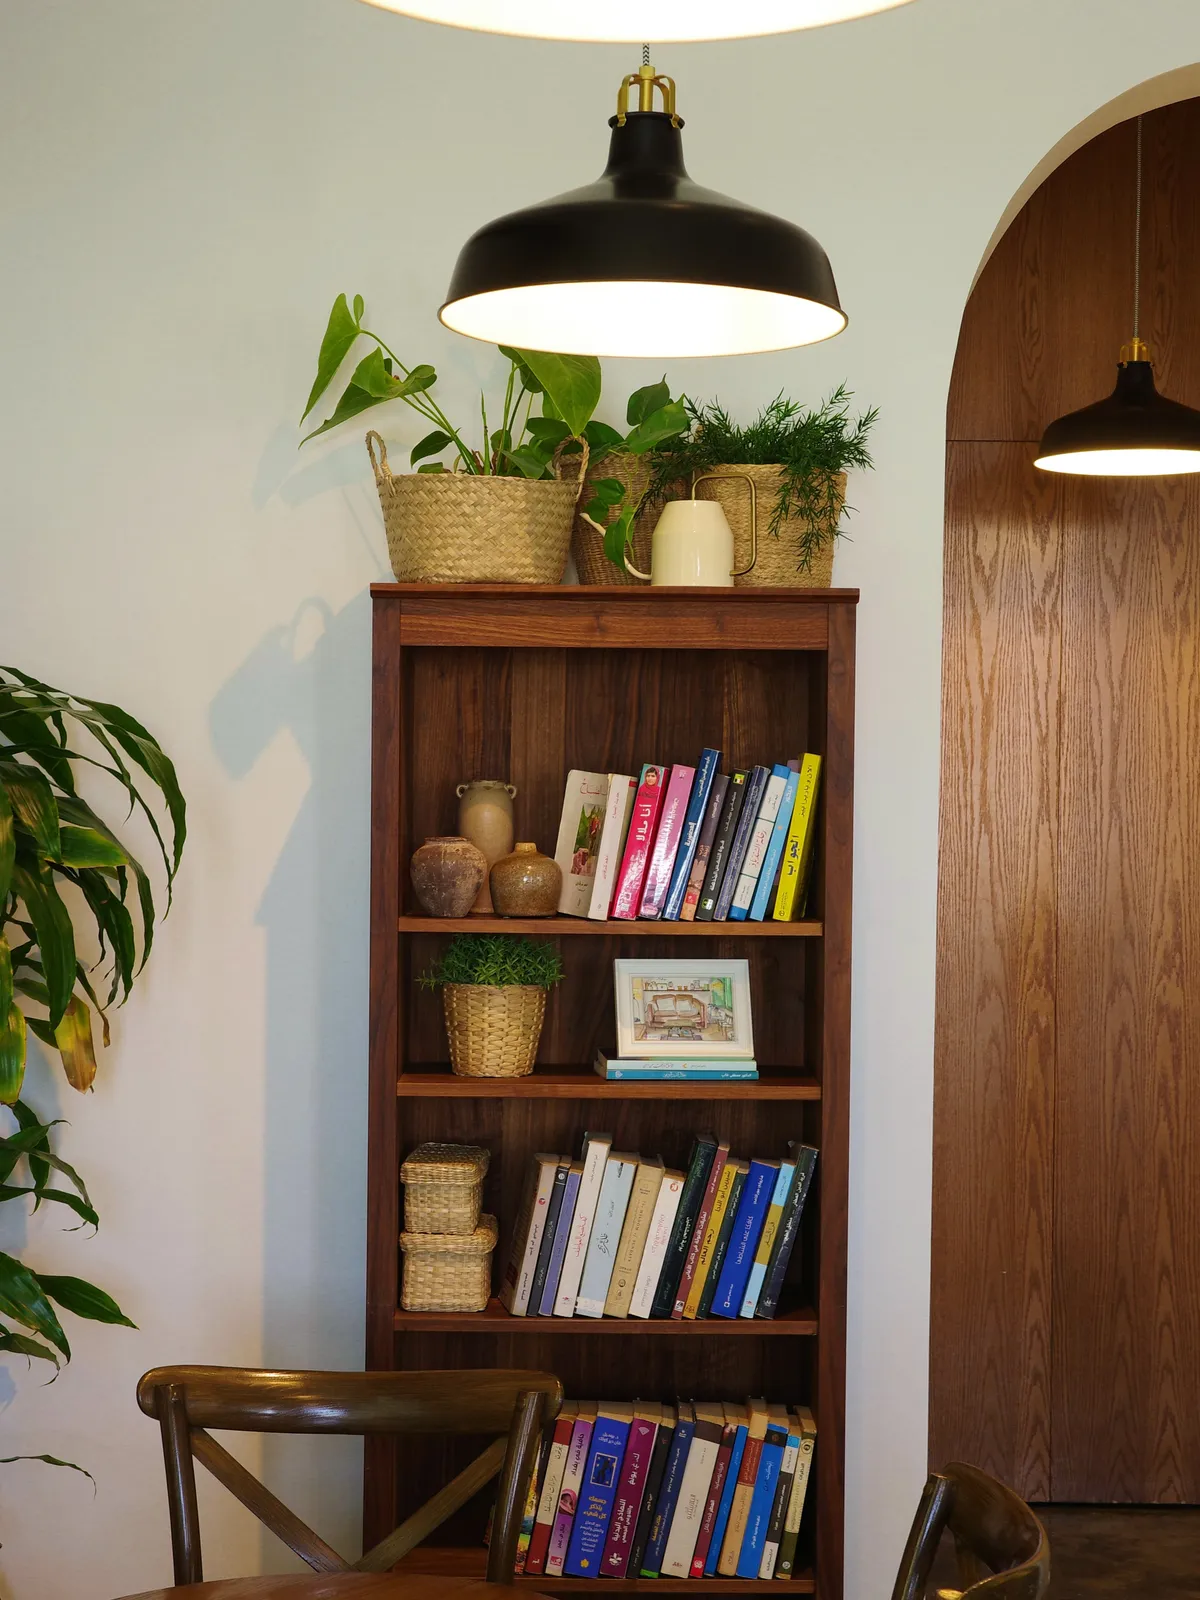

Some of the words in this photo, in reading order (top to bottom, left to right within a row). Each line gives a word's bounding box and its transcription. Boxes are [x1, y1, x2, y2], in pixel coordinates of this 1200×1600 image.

[639, 804, 652, 817] أنا
[636, 820, 648, 841] ملالا
[684, 821, 697, 847] العصفورية
[787, 835, 800, 875] الجواب
[715, 1200, 723, 1212] النجا
[745, 1216, 754, 1230] كافكا
[735, 1242, 746, 1265] الشاطئ
[576, 1433, 585, 1449] حافية
[571, 1461, 580, 1476] بغداد
[628, 1471, 637, 1485] يونغ
[588, 1496, 607, 1504] جسمك
[589, 1503, 603, 1511] يتذكر
[583, 1510, 598, 1518] شيء
[617, 1499, 626, 1521] النماذج
